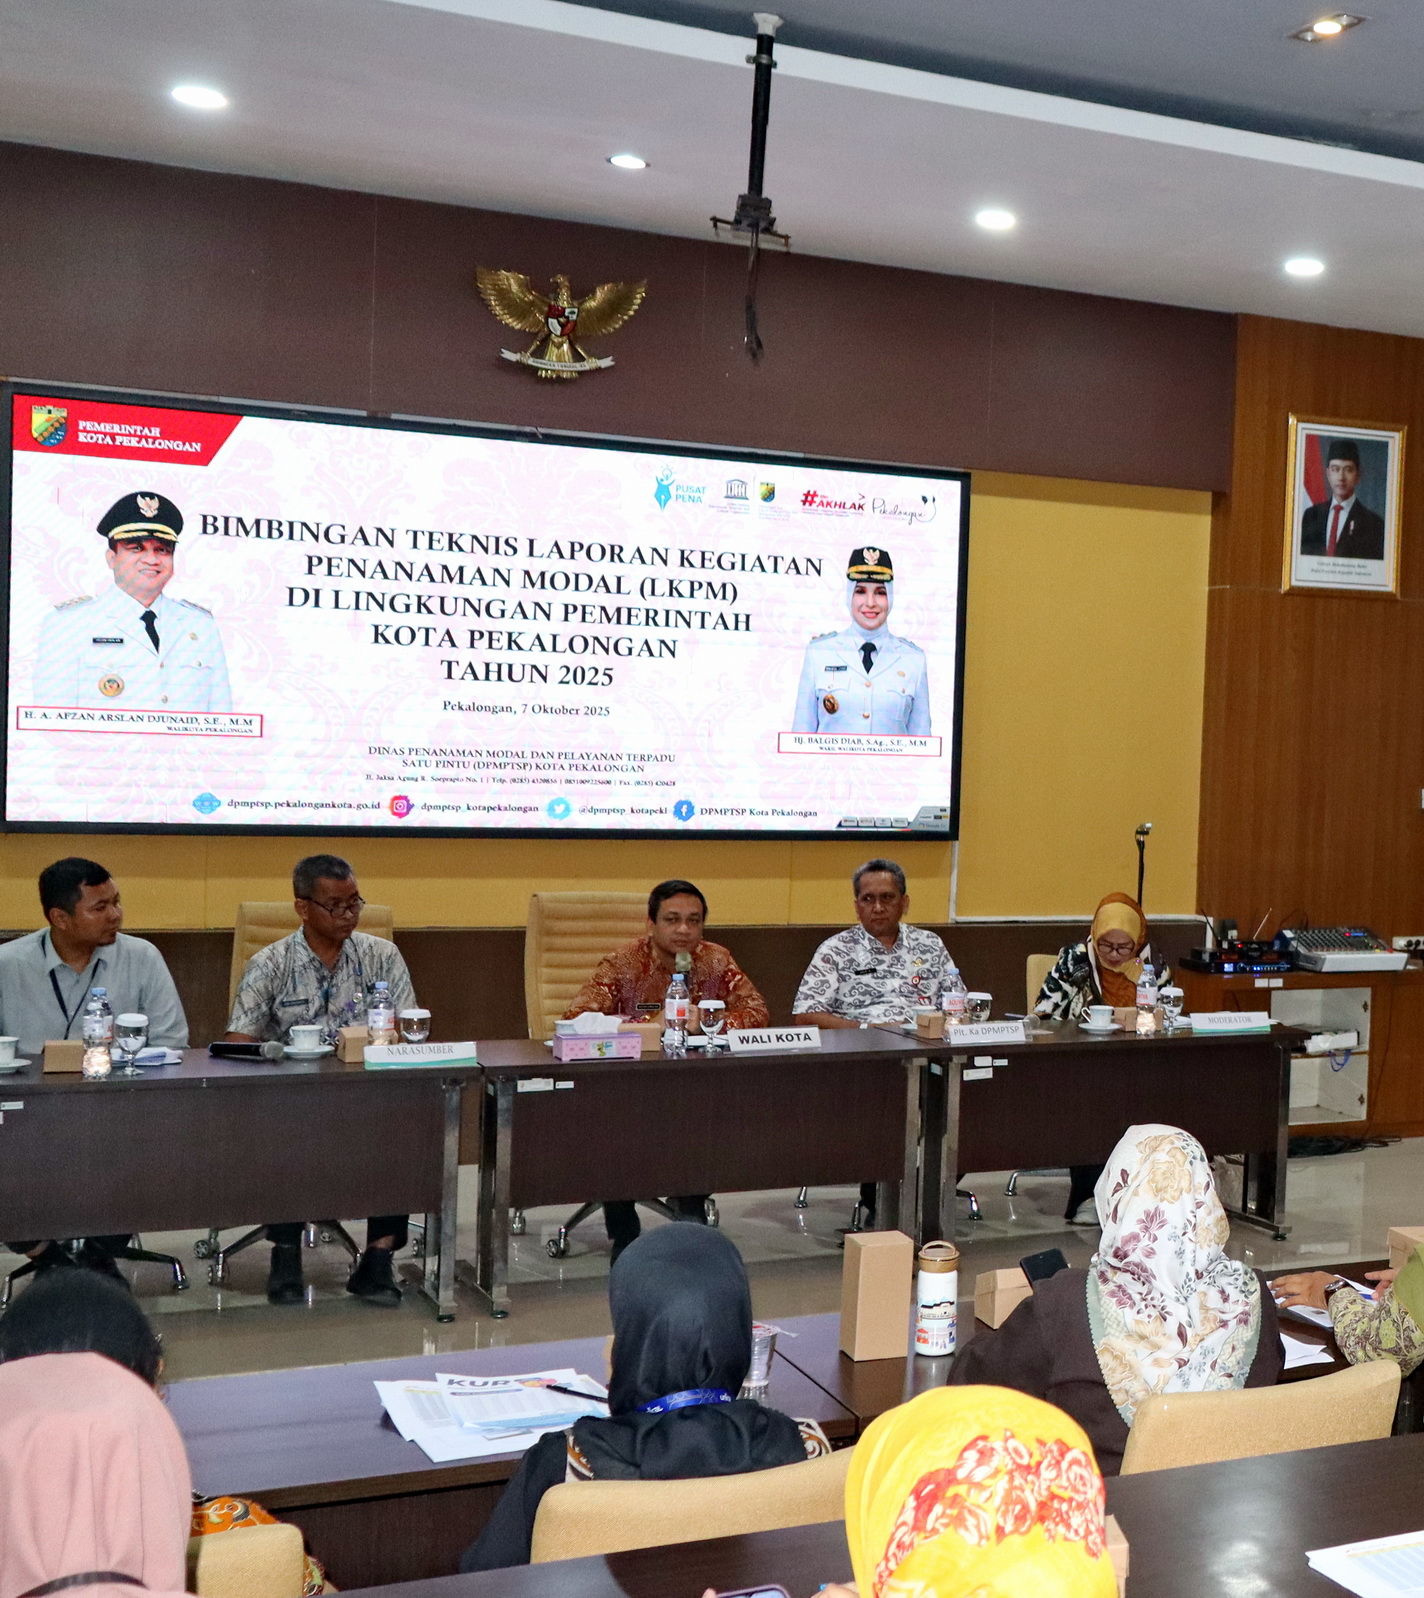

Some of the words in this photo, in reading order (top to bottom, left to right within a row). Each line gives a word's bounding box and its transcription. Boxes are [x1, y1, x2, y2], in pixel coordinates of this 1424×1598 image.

[78, 420, 160, 437] PEMERINTAH
[78, 432, 113, 445] KOTA
[115, 435, 202, 452] PEKALONGAN
[675, 484, 706, 495] PUSAT
[675, 494, 703, 504] PENA
[199, 513, 397, 549] BIMBINGAN
[405, 529, 518, 558] TEKNIS
[527, 537, 670, 568] LAPORAN
[678, 548, 824, 578] KEGIATAN
[304, 554, 513, 589] PENANAMAN
[520, 568, 632, 596] MODAL
[639, 576, 738, 606] (LKPM)
[285, 586, 323, 609] DI
[331, 589, 554, 622] LINGKUNGAN
[562, 602, 752, 632] PEMERINTAH
[371, 623, 459, 649] KOTA
[467, 629, 678, 659] PEKALONGAN
[440, 659, 550, 685] TAHUN
[557, 665, 614, 687] 2025
[442, 700, 517, 715] Pekalongan,
[521, 703, 528, 714] 7
[531, 703, 580, 716] Oktober
[583, 705, 611, 717] 2025
[24, 711, 36, 719] H.
[40, 711, 52, 720] A.
[55, 712, 95, 722] AFZAN
[98, 713, 145, 723] ARSLAN
[147, 715, 201, 726] DJUNAID,
[229, 717, 253, 727] M.M
[808, 737, 839, 746] BALGIS
[368, 746, 405, 756] DINAS
[408, 747, 483, 758] PENANAMAN
[485, 749, 528, 759] MODAL
[530, 750, 555, 760] DAN
[557, 751, 623, 762] PELAYANAN
[626, 753, 676, 763] TERPADU
[402, 758, 432, 768] SATU
[435, 759, 471, 769] PINTU
[473, 760, 533, 772] (DPMPTSP)
[535, 762, 565, 772] KOTA
[568, 763, 645, 773] PEKALONGAN
[227, 799, 381, 811] dpmptsp.pekalongankota.go.id
[700, 807, 747, 816] DPMPTSP
[749, 808, 769, 817] Kota
[771, 808, 818, 819] Pekalongan
[1207, 1016, 1252, 1025] MODERATOR
[738, 1034, 771, 1045] WALI
[775, 1032, 813, 1043] KOTA
[970, 1027, 980, 1036] Ka
[981, 1026, 1020, 1035] DPMPTSP
[387, 1045, 454, 1056] NARASUMBER
[446, 1377, 512, 1388] KUR
